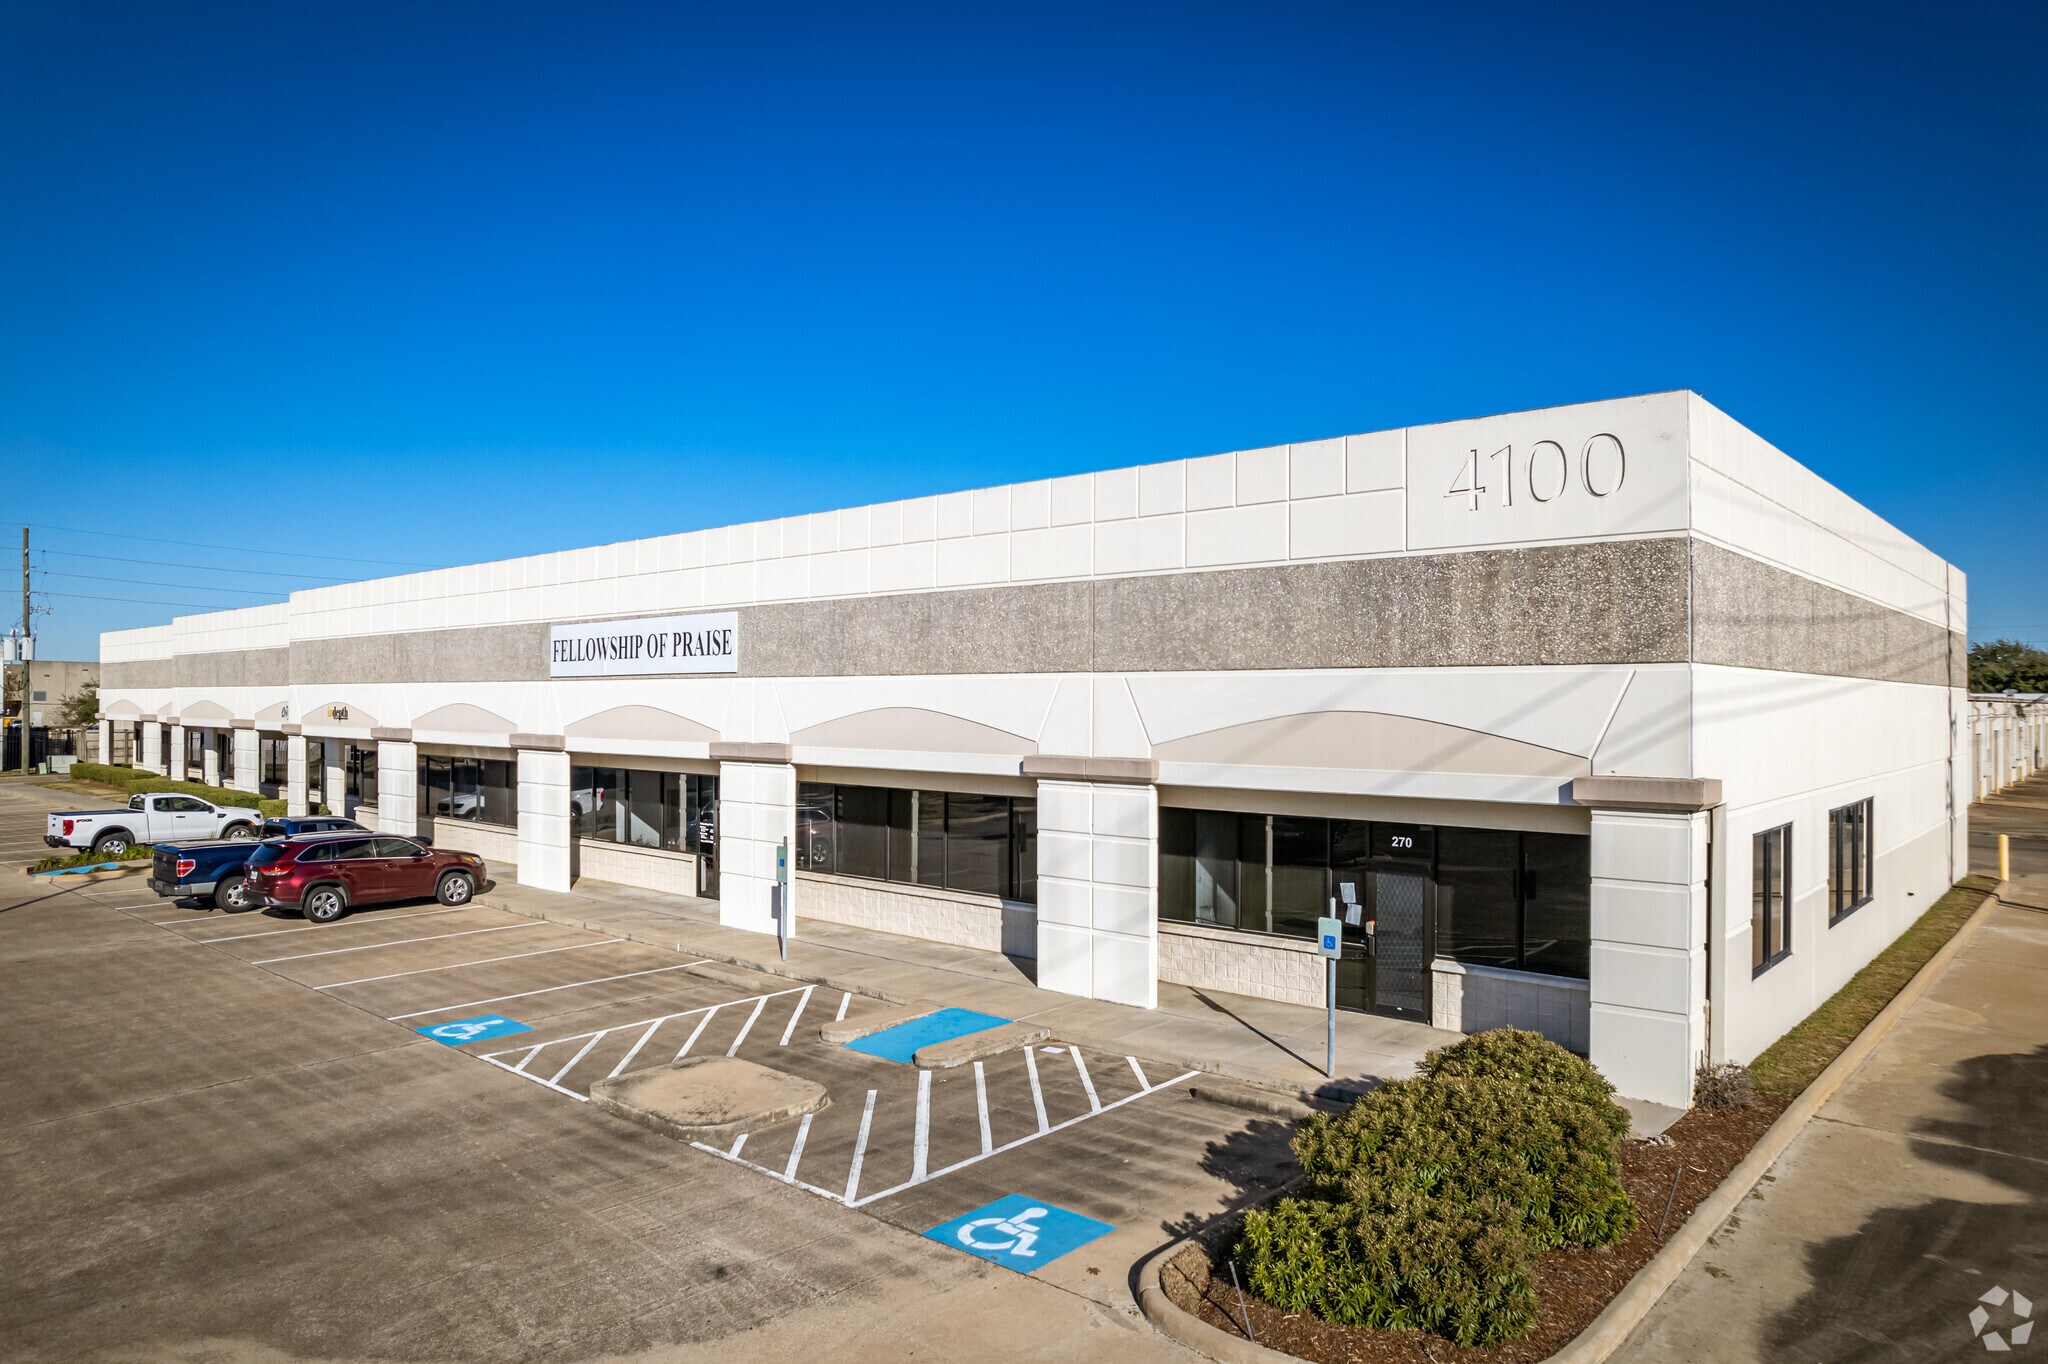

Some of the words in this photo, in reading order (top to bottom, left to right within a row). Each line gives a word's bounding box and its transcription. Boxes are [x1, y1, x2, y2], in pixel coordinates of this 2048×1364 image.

[1443, 432, 1626, 512] 4100
[552, 634, 643, 663] FELLOWSHIP
[646, 632, 668, 659] OF
[672, 629, 732, 658] PRAISE
[1391, 836, 1413, 848] 270
